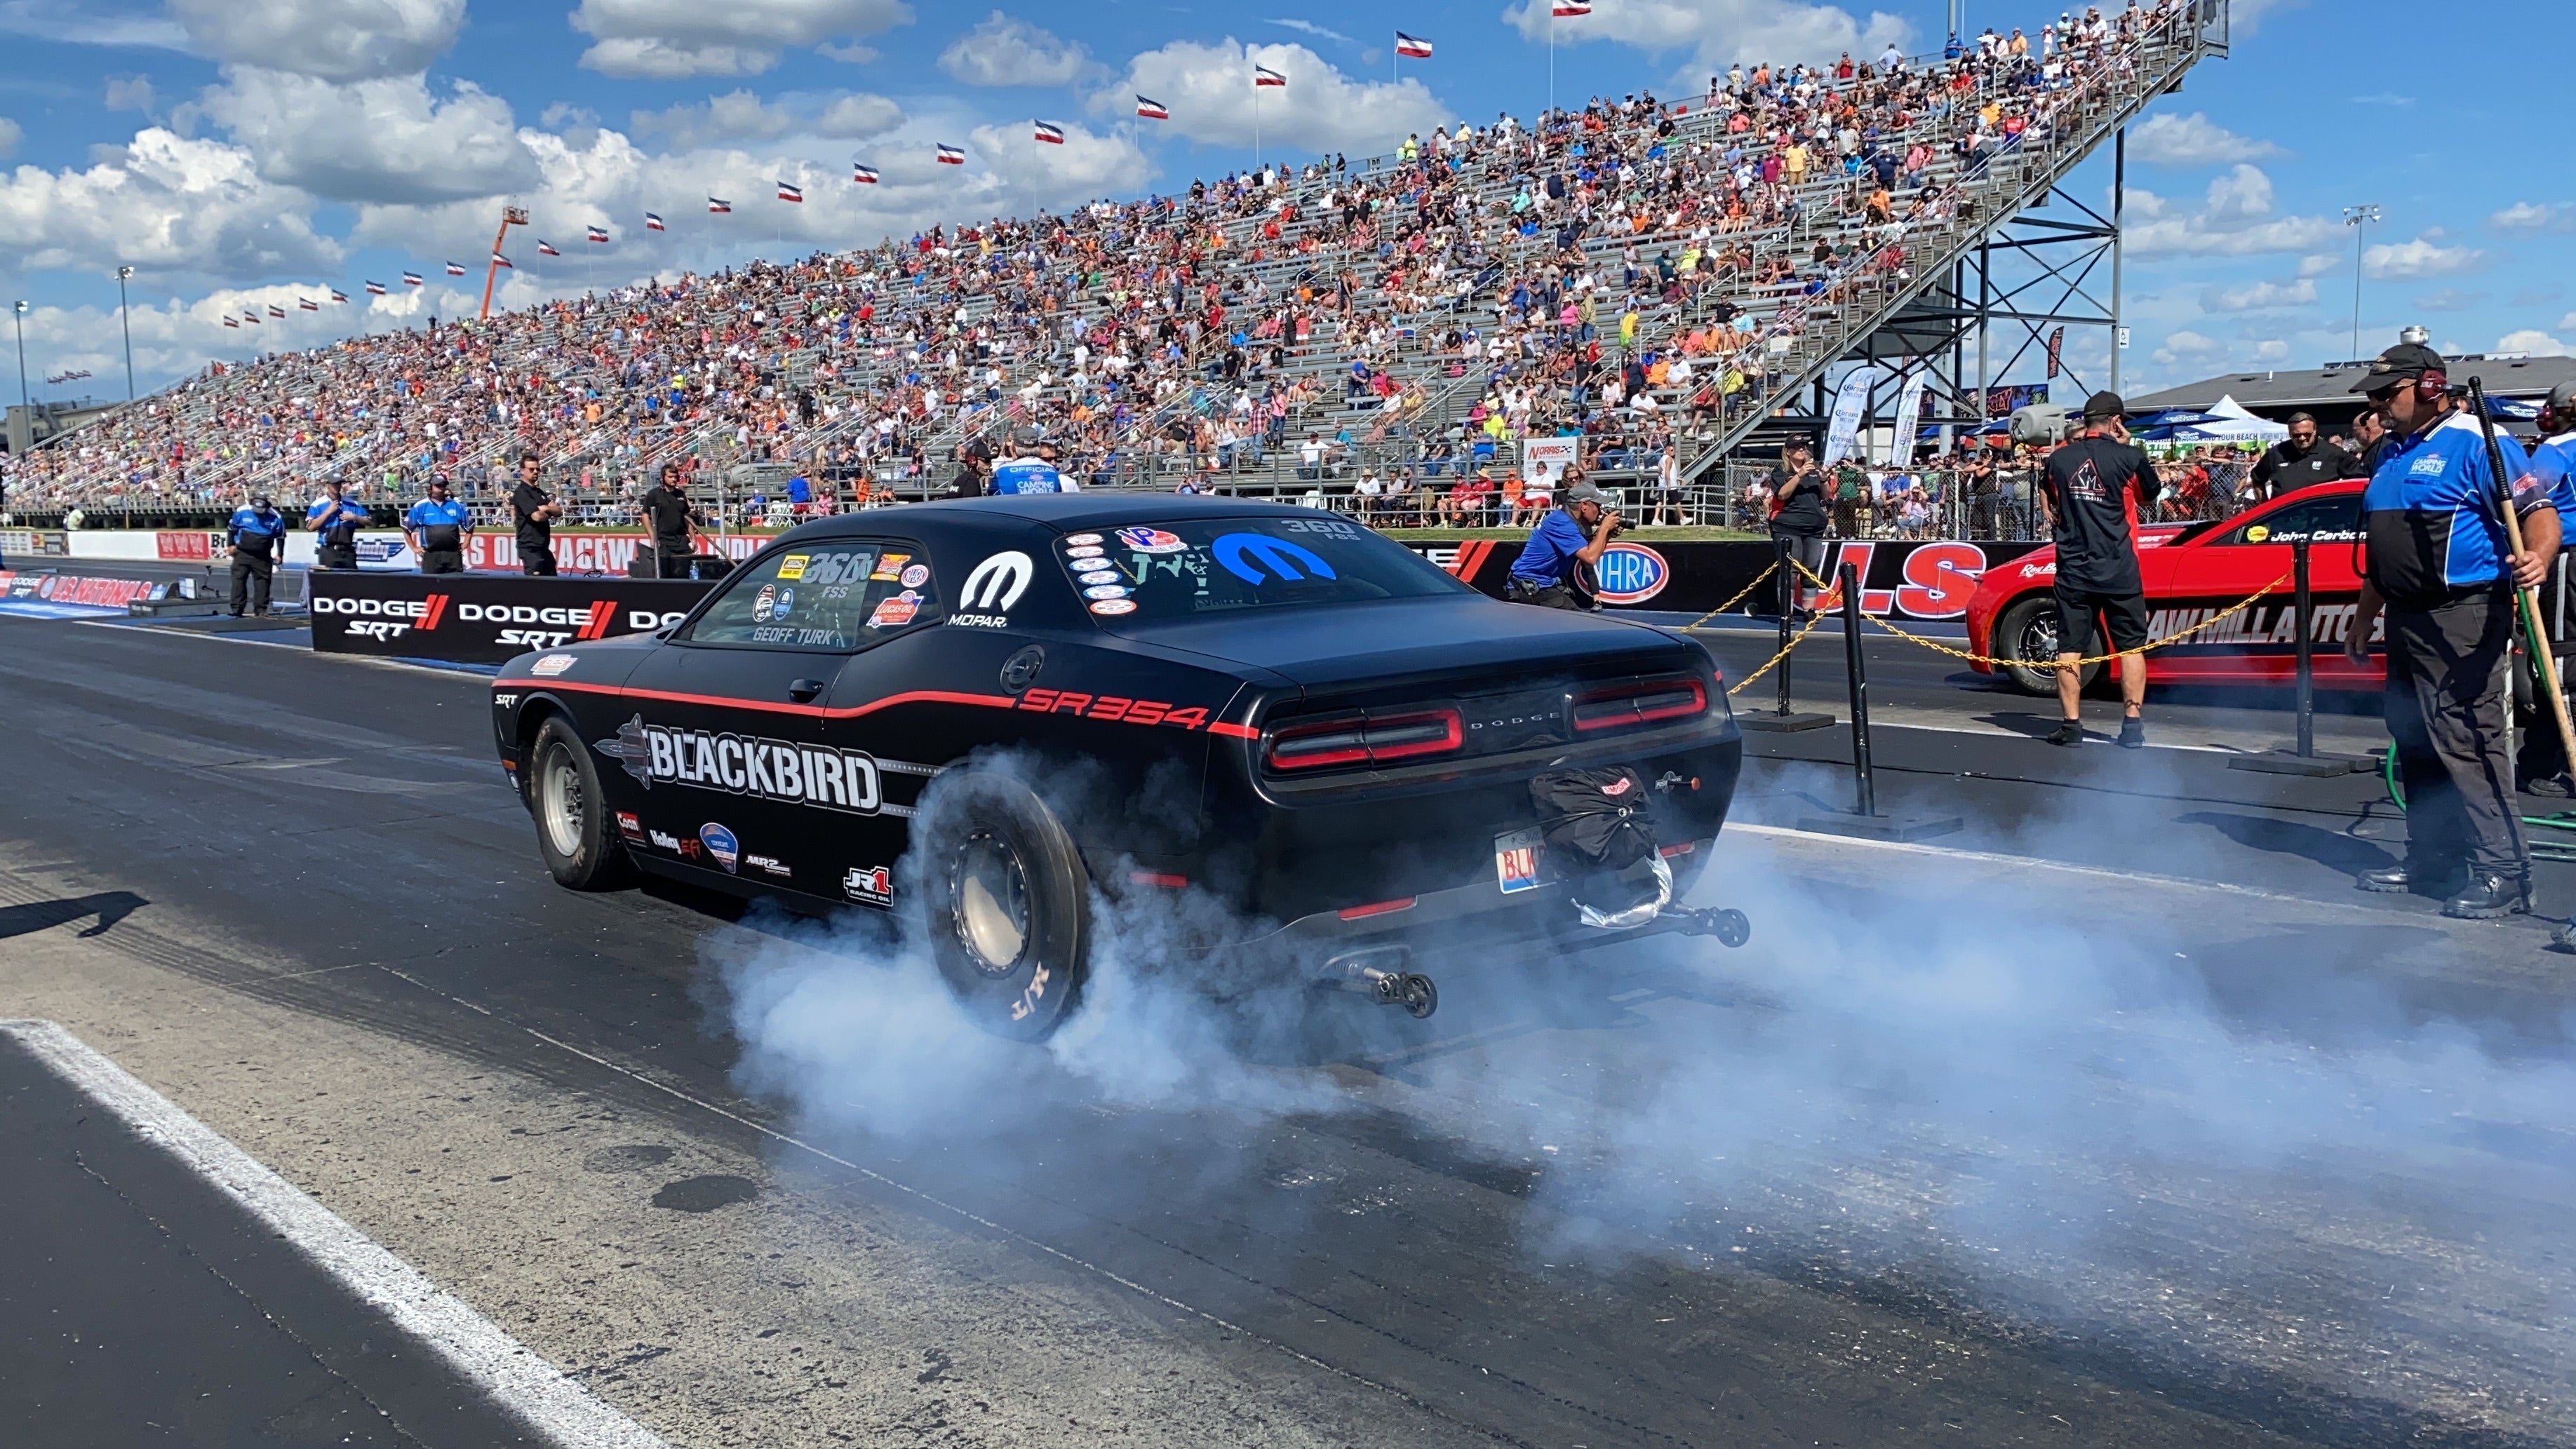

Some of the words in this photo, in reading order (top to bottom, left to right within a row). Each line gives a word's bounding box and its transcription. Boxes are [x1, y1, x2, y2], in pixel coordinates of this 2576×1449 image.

[1528, 445, 1561, 460] NORRIS
[2411, 464, 2443, 473] WORLD
[1281, 520, 1355, 534] 360
[1115, 527, 1155, 546] VP
[2271, 532, 2308, 541] John
[800, 553, 873, 584] 360
[905, 569, 925, 584] NHRA
[13, 577, 41, 587] DODGE
[821, 586, 849, 598] FSS
[313, 597, 429, 619] DODGE
[459, 604, 593, 626] DODGE
[879, 605, 902, 614] LUCAS
[901, 605, 913, 614] OIL
[948, 614, 1005, 627] MOPAR
[344, 621, 410, 642] SRT
[753, 626, 796, 643] GEOFF
[796, 628, 836, 646] TURK
[495, 629, 572, 651] SRT
[495, 694, 518, 708] SRT
[1018, 688, 1209, 729] SR354
[1472, 713, 1559, 729] DODGE
[650, 730, 878, 810] BLACKBIRD
[650, 829, 682, 855] Holley
[846, 870, 889, 895] JR1
[850, 889, 877, 900] RACING
